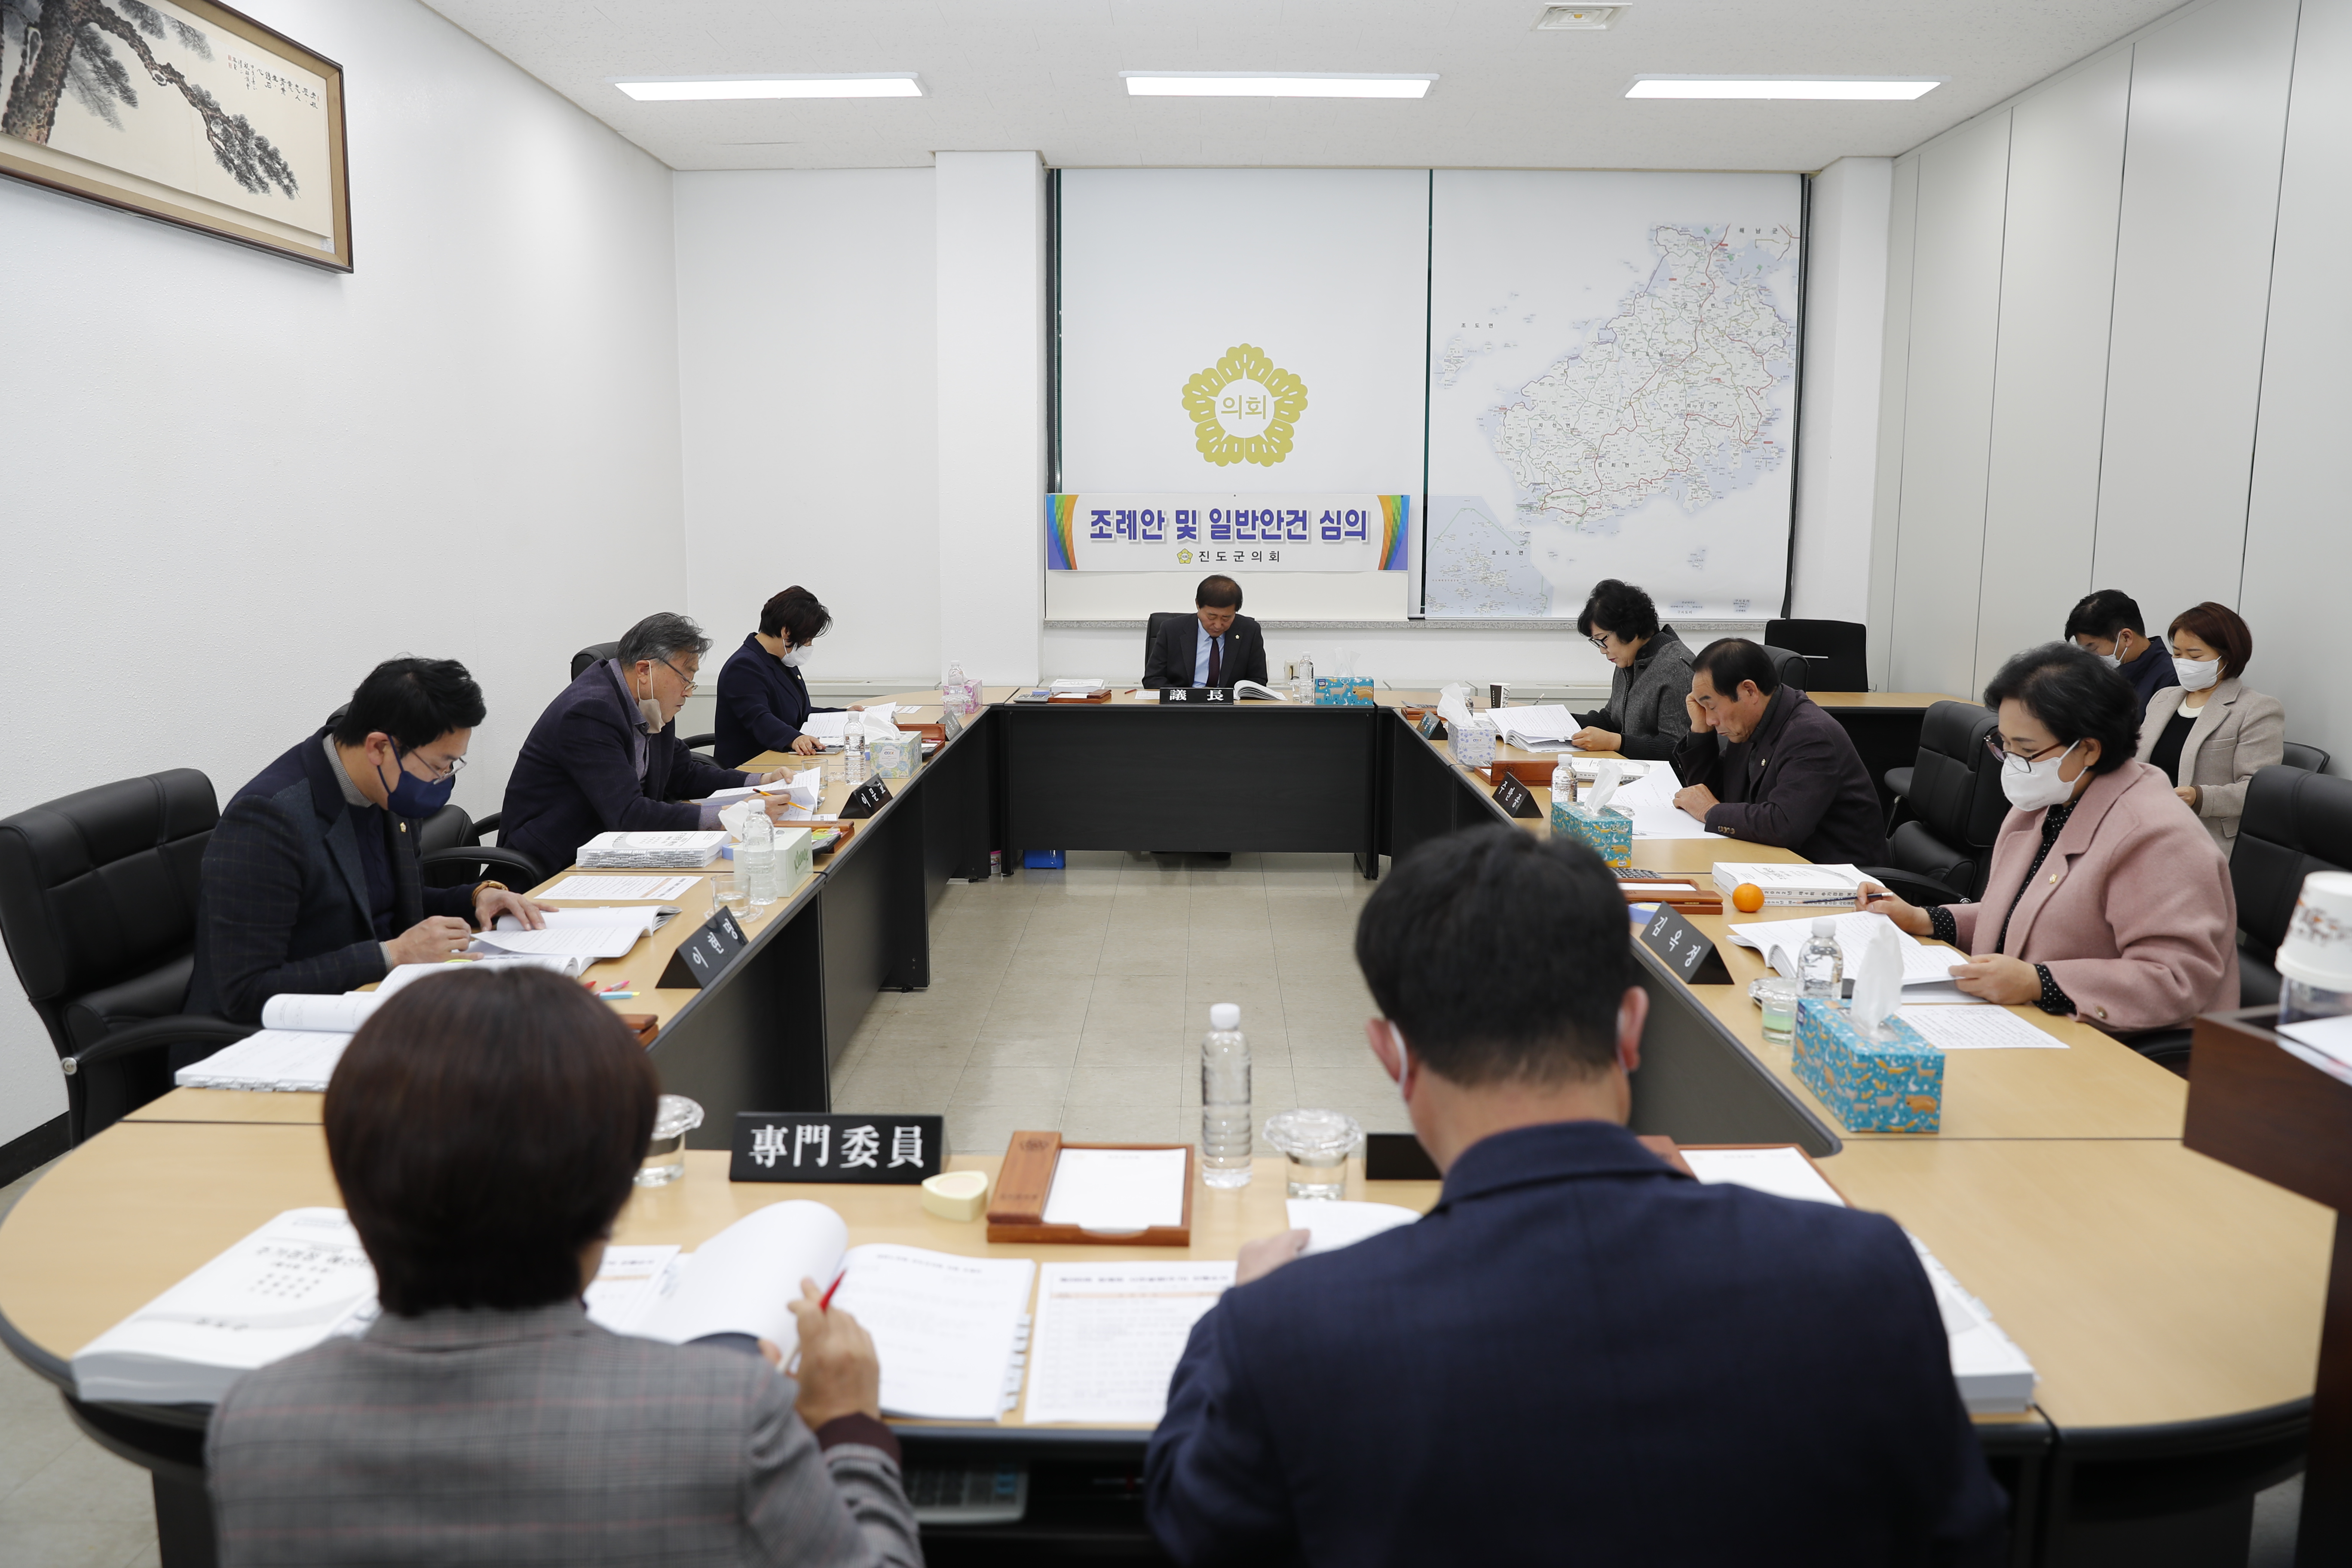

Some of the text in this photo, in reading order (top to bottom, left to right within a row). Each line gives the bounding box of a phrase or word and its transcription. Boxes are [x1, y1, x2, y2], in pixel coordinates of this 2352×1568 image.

[1221, 394, 1266, 420] 의회
[1090, 508, 1366, 540] 조례안 및 일반안건 심의
[1198, 550, 1280, 562] 진도군의회
[1169, 689, 1224, 701] 議長
[861, 782, 886, 808] 이문교
[692, 918, 738, 968] 이현명
[1651, 916, 1701, 968] 김옥정
[748, 1124, 925, 1169] 專門委員
